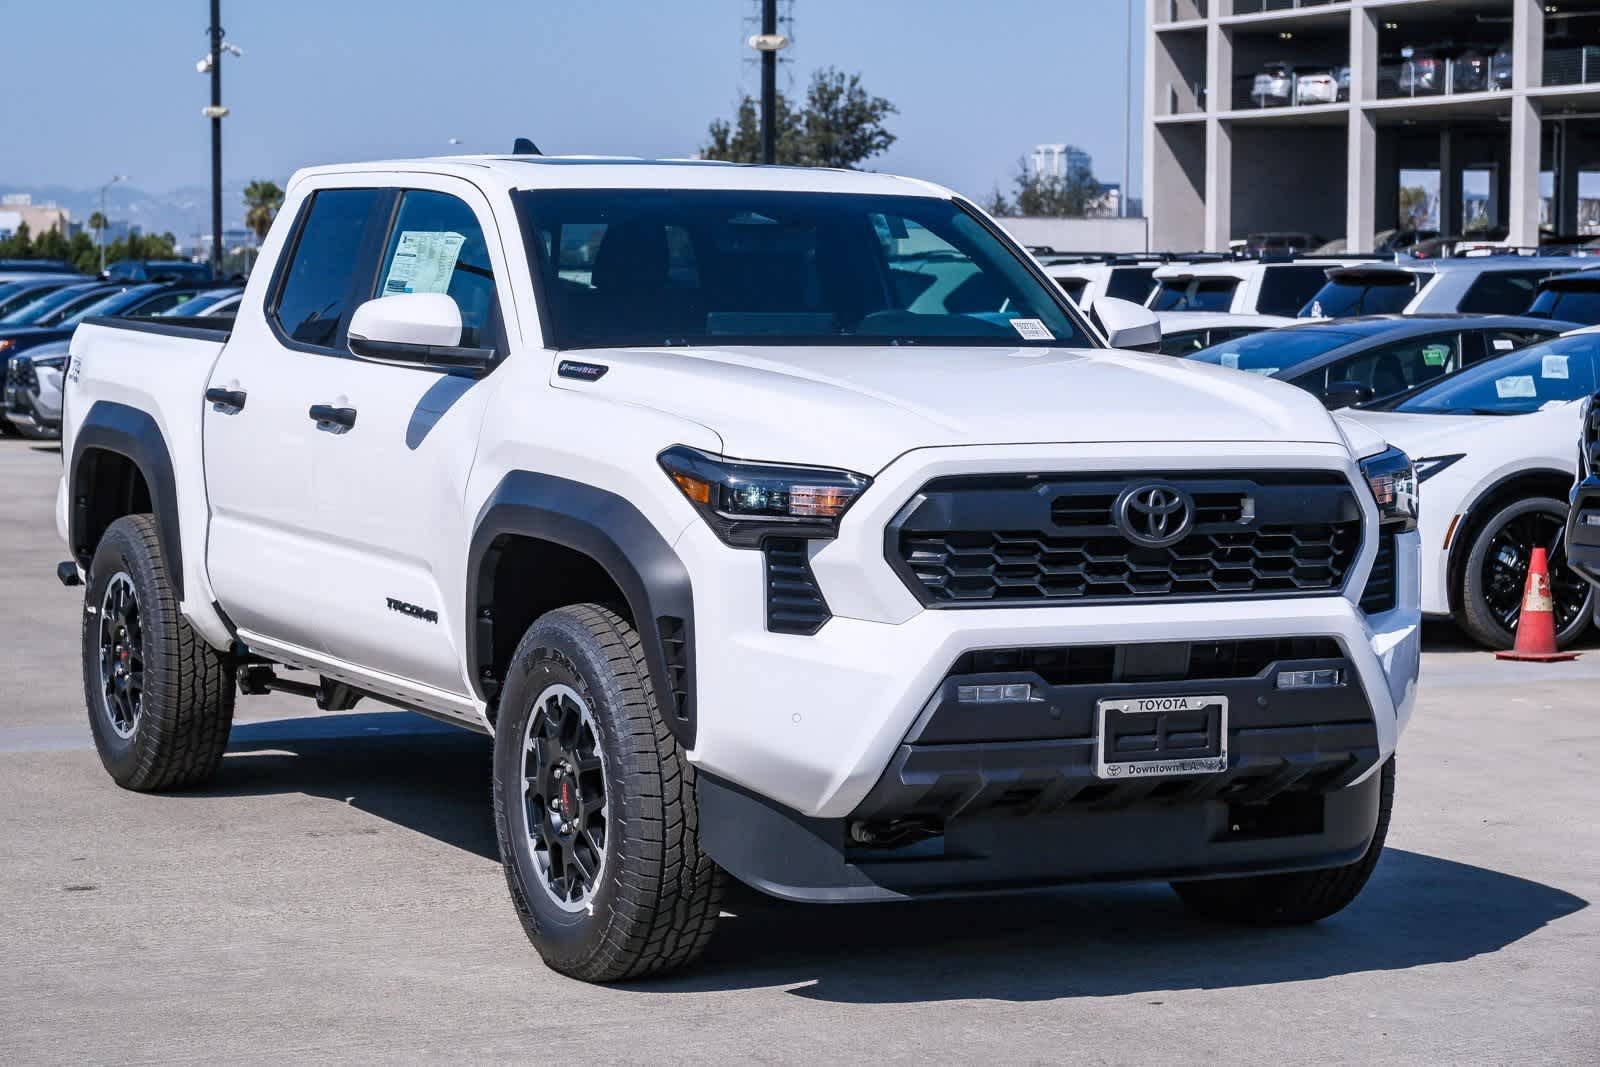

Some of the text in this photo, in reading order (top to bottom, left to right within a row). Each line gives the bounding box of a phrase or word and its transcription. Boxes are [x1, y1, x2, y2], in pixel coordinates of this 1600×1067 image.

[386, 597, 438, 624] TACOMA
[1138, 699, 1188, 711] TOYOTA
[1128, 764, 1179, 775] Downtown
